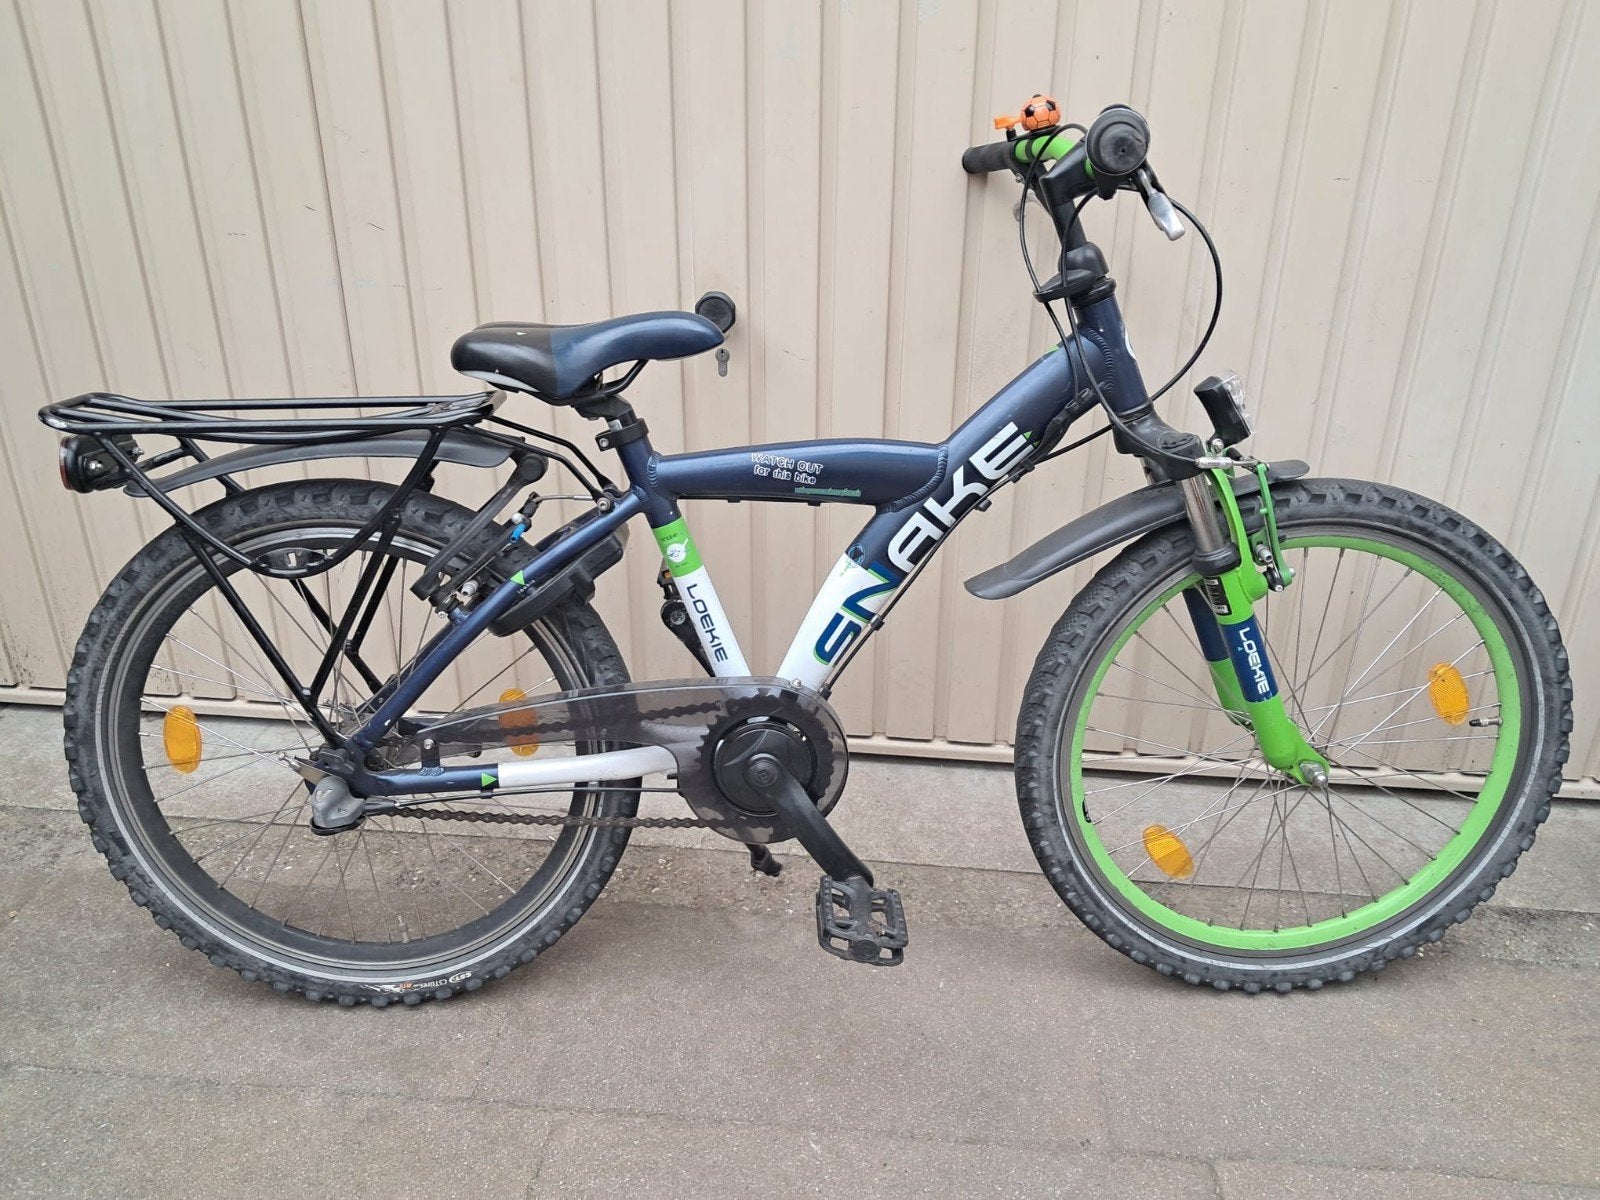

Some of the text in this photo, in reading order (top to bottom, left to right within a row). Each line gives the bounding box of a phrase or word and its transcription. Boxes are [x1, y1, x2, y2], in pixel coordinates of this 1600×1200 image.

[751, 452, 824, 475] WATCH OUT
[753, 464, 817, 485] for this bike
[813, 421, 1036, 666] SNAKE
[686, 583, 728, 663] LOEKIE
[1239, 627, 1270, 694] LOEKIE
